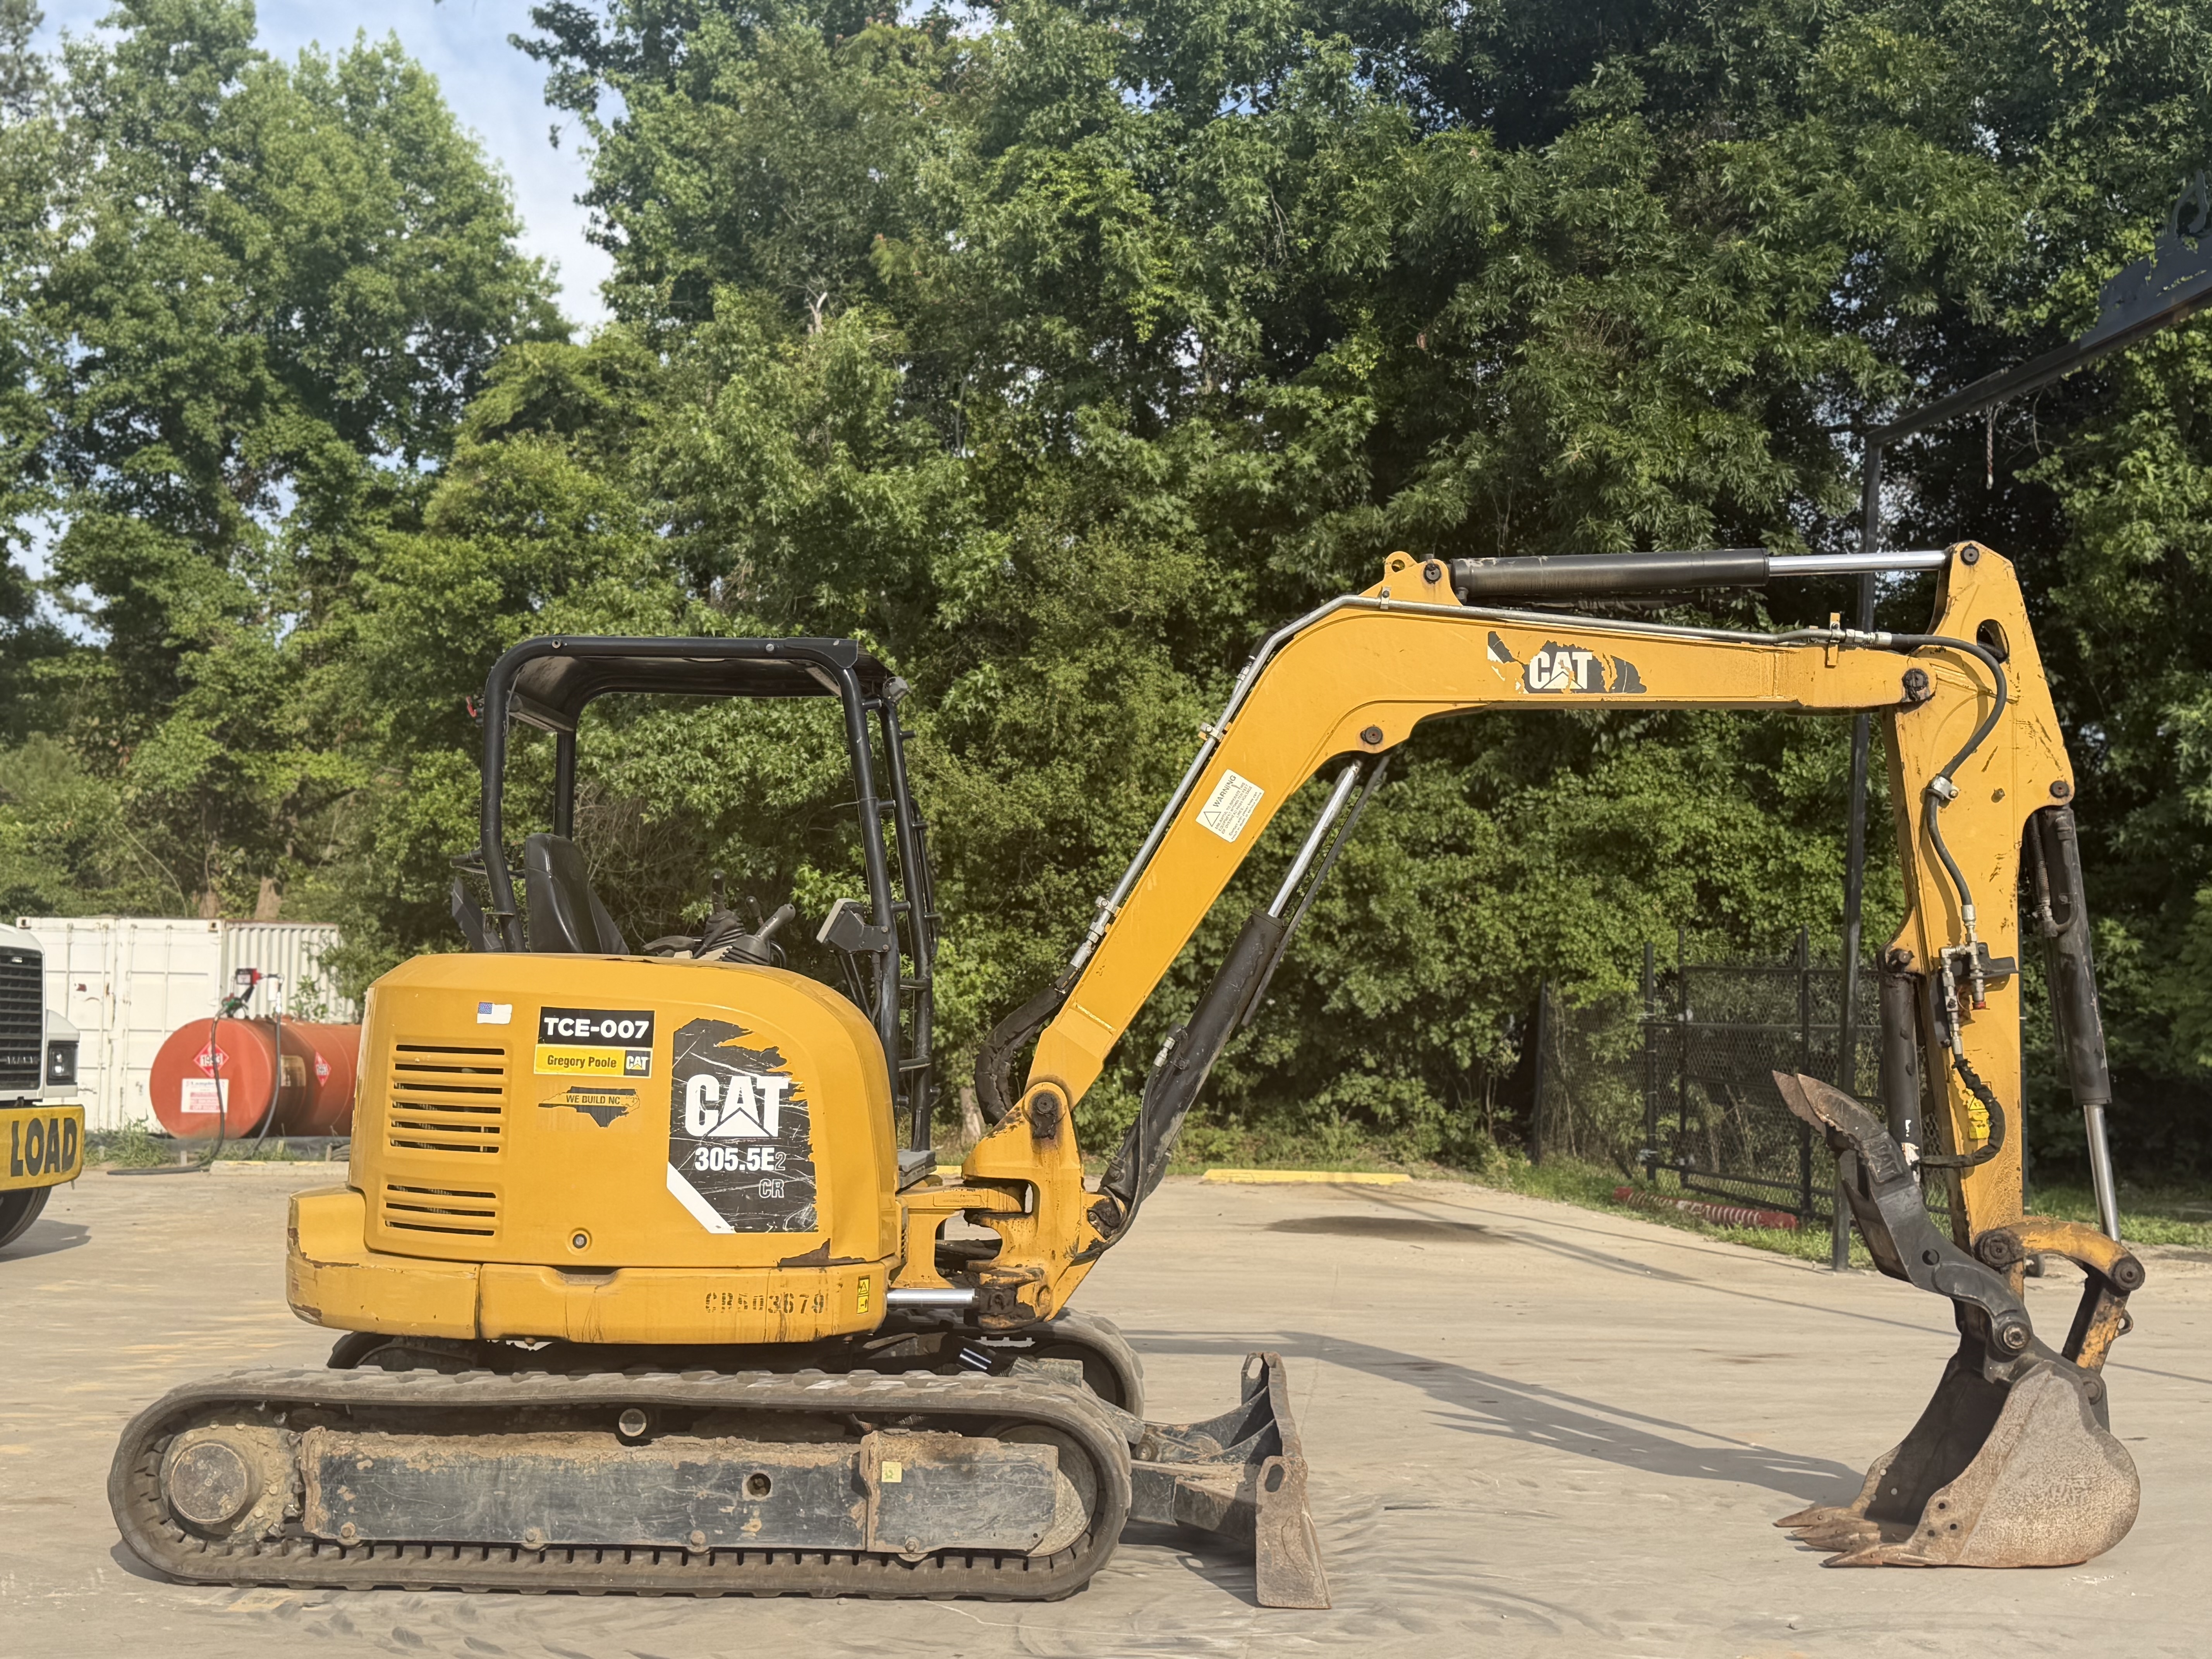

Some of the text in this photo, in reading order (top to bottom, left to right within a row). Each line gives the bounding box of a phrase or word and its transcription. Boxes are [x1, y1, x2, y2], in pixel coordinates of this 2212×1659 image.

[1530, 651, 1593, 689] CAT
[1212, 775, 1237, 808] WARNING
[544, 1017, 649, 1039] TCE-007
[547, 1054, 648, 1070] Gregory Poole CAT
[566, 1094, 620, 1105] WE BUILD NC
[685, 1074, 789, 1137] CAT
[11, 1117, 77, 1177] LOAD
[695, 1147, 786, 1171] 305.5E2
[759, 1178, 785, 1198] CR
